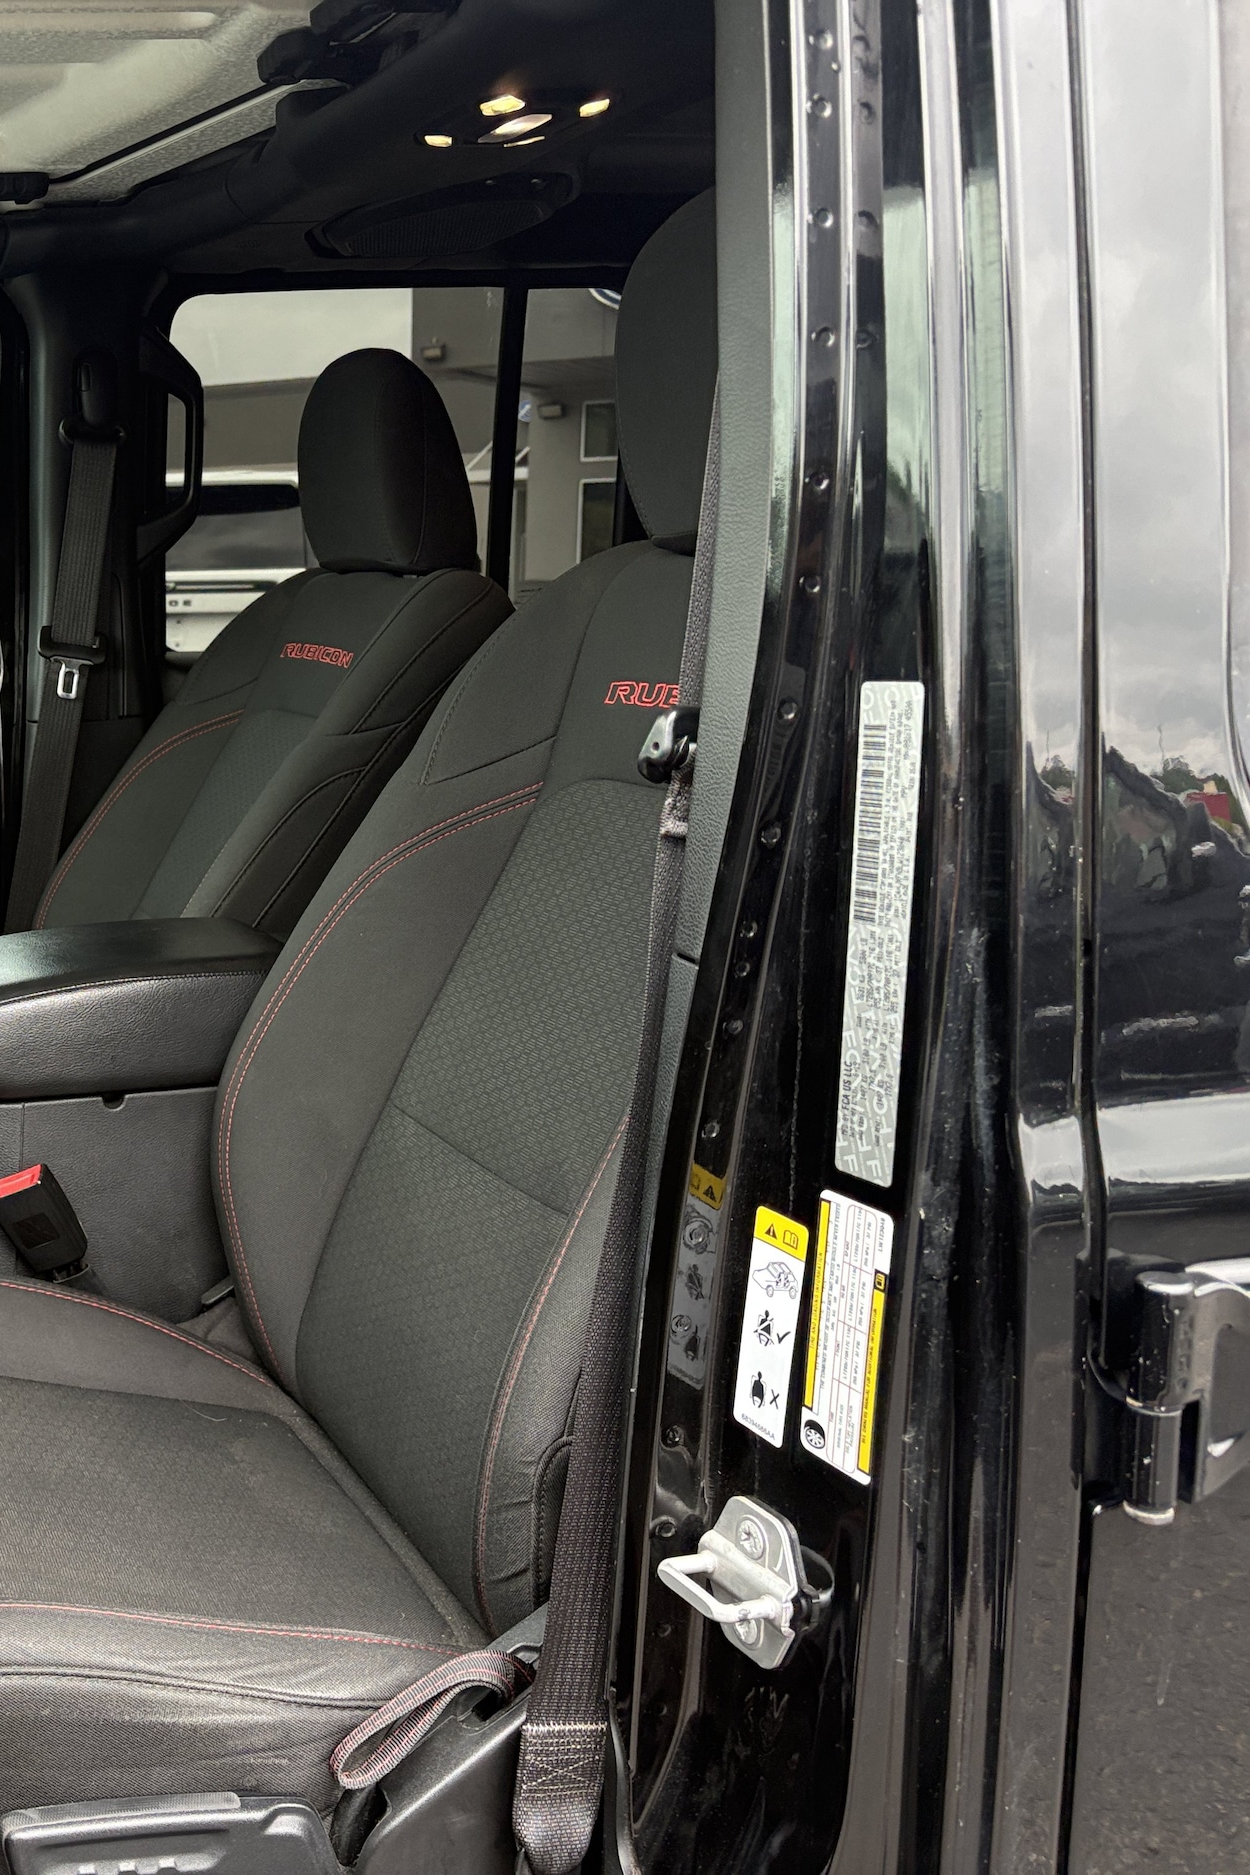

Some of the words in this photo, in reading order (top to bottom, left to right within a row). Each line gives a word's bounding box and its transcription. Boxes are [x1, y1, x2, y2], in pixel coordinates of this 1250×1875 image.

[280, 642, 354, 669] RUBICON
[604, 681, 680, 709] RUB
[843, 1060, 852, 1077] LLC
[842, 1078, 850, 1092] US
[841, 1092, 850, 1111] FCA
